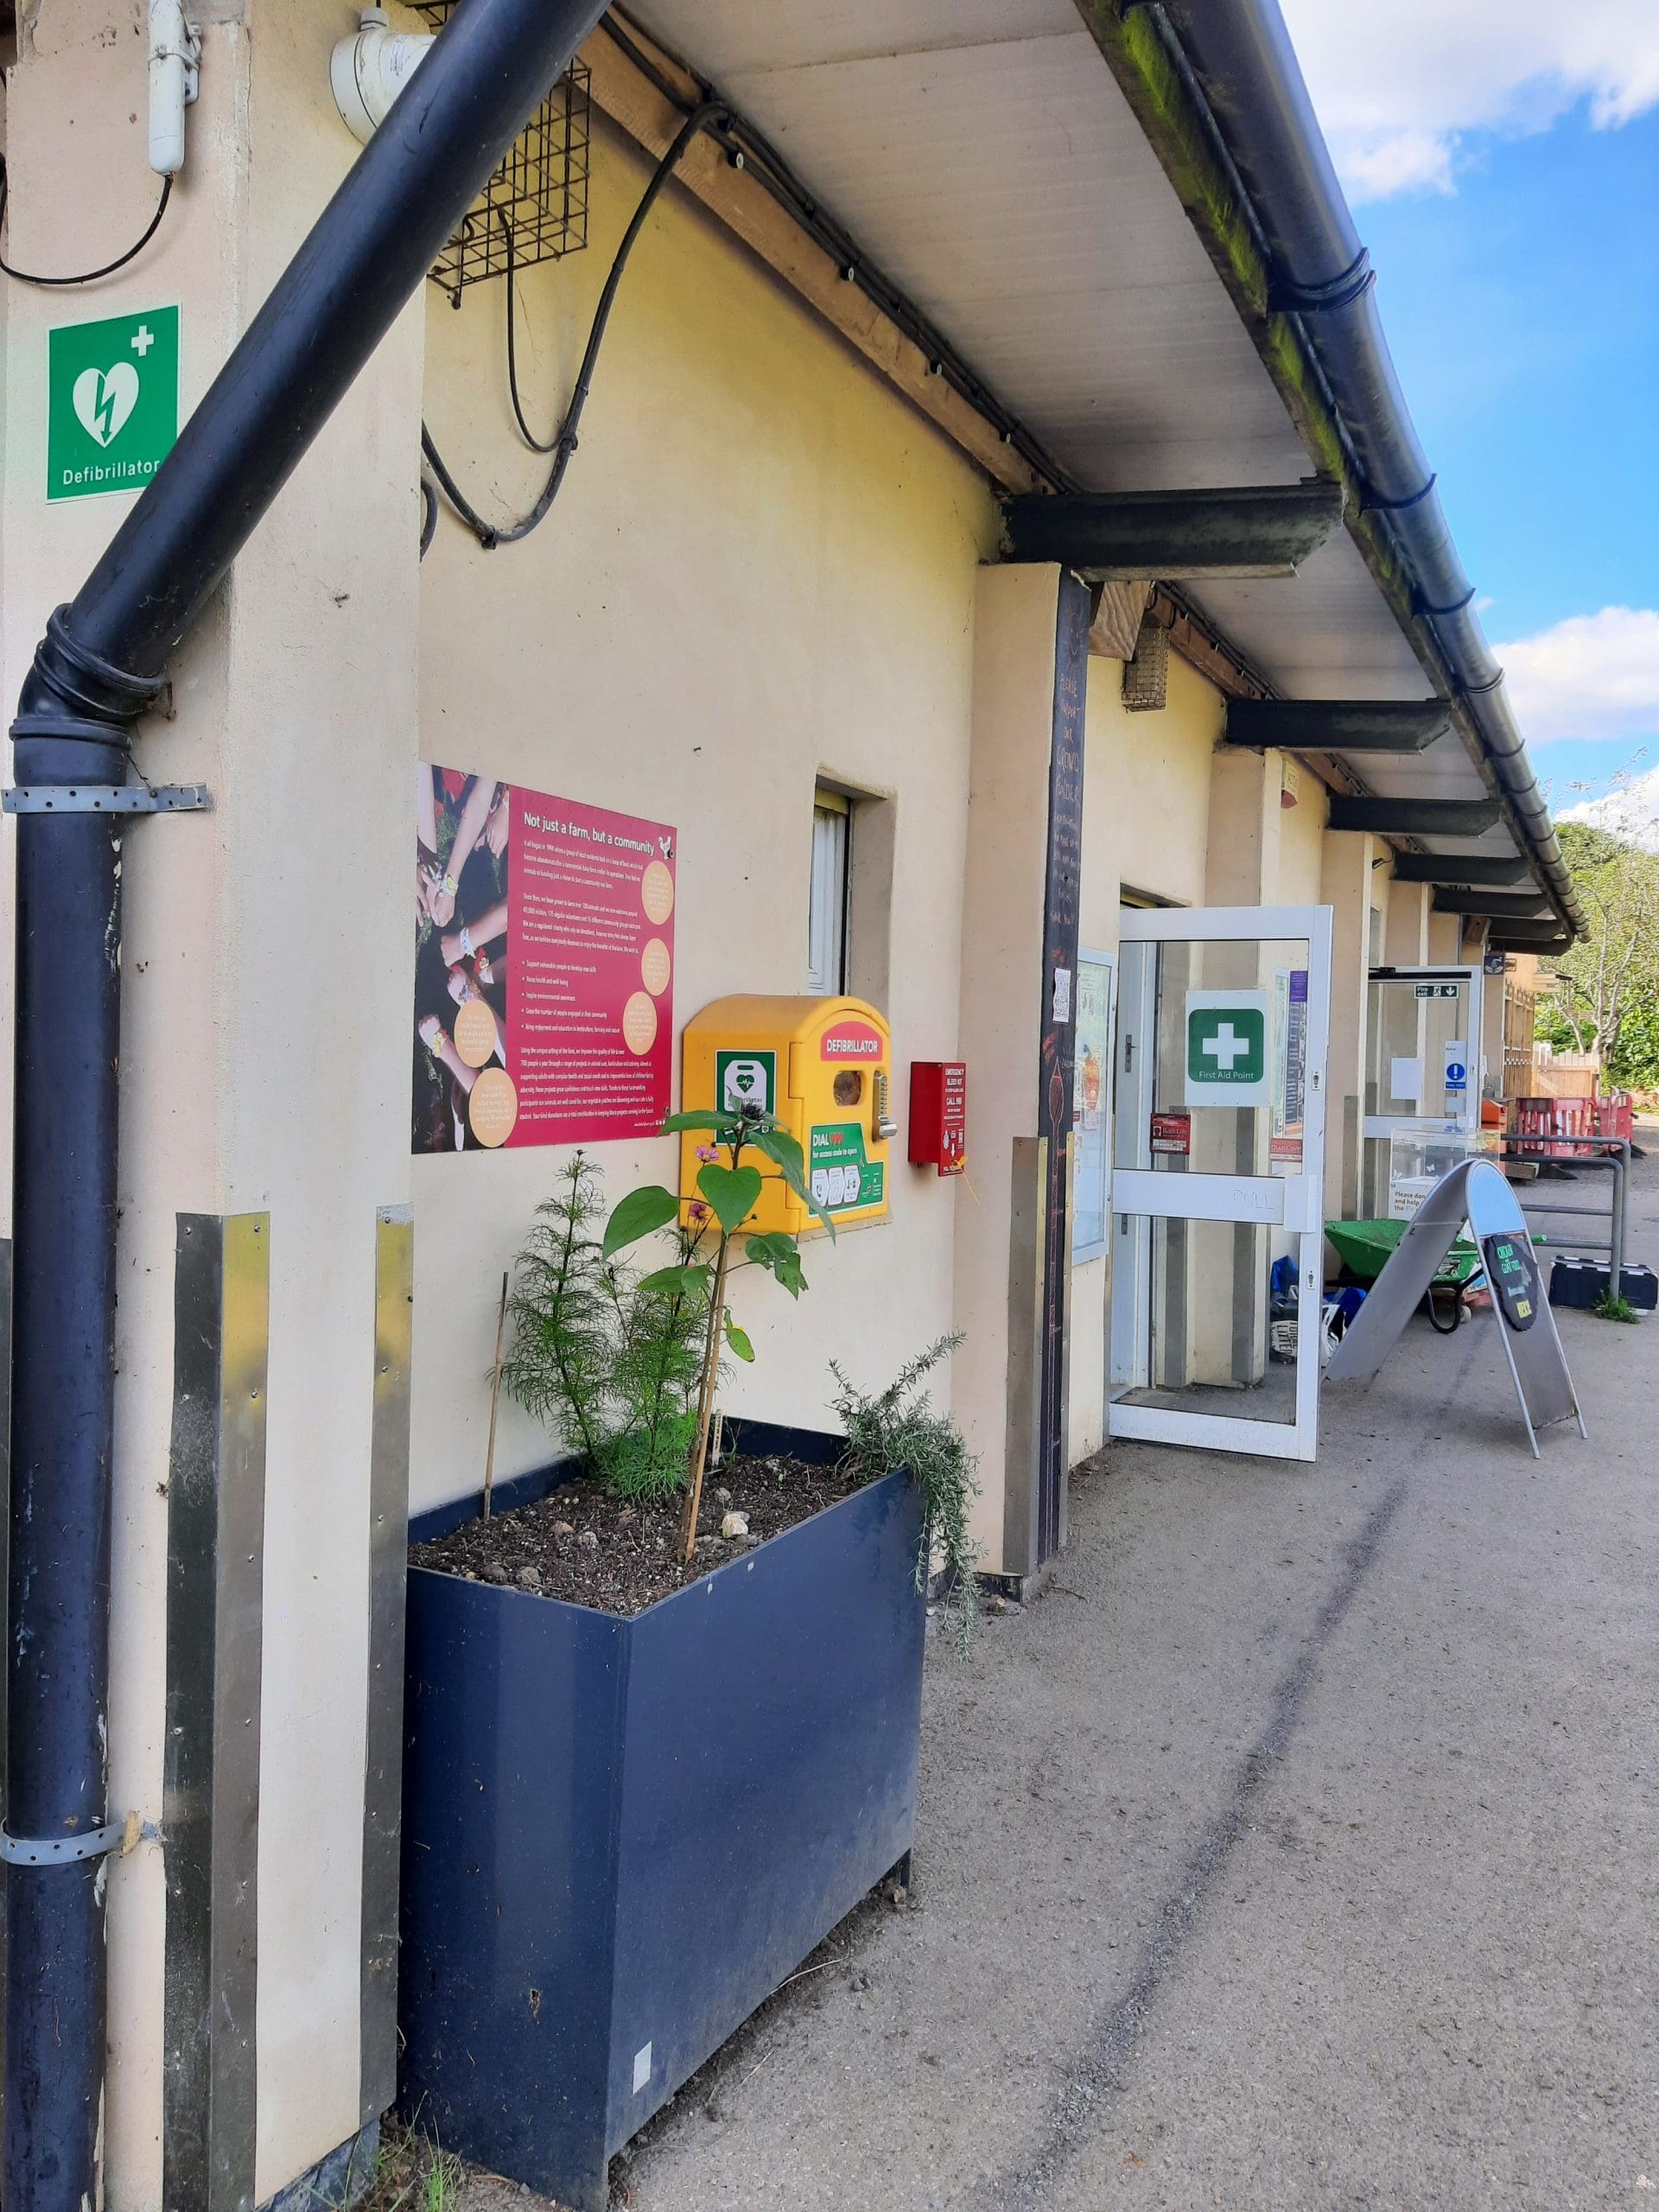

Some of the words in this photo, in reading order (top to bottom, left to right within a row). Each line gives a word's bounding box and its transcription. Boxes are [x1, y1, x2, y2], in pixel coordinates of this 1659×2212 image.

[63, 459, 161, 486] Defibrillator
[524, 812, 540, 828] Not
[542, 816, 559, 833] just
[561, 821, 566, 834] a
[569, 822, 590, 840] farm,
[592, 828, 606, 843] but
[607, 832, 612, 844] a
[614, 835, 655, 857] community
[826, 1039, 878, 1053] DEFIBRILLATOR
[946, 1097, 956, 1106] CALL
[812, 1133, 830, 1147] DIAL
[1232, 1189, 1275, 1210] PULL
